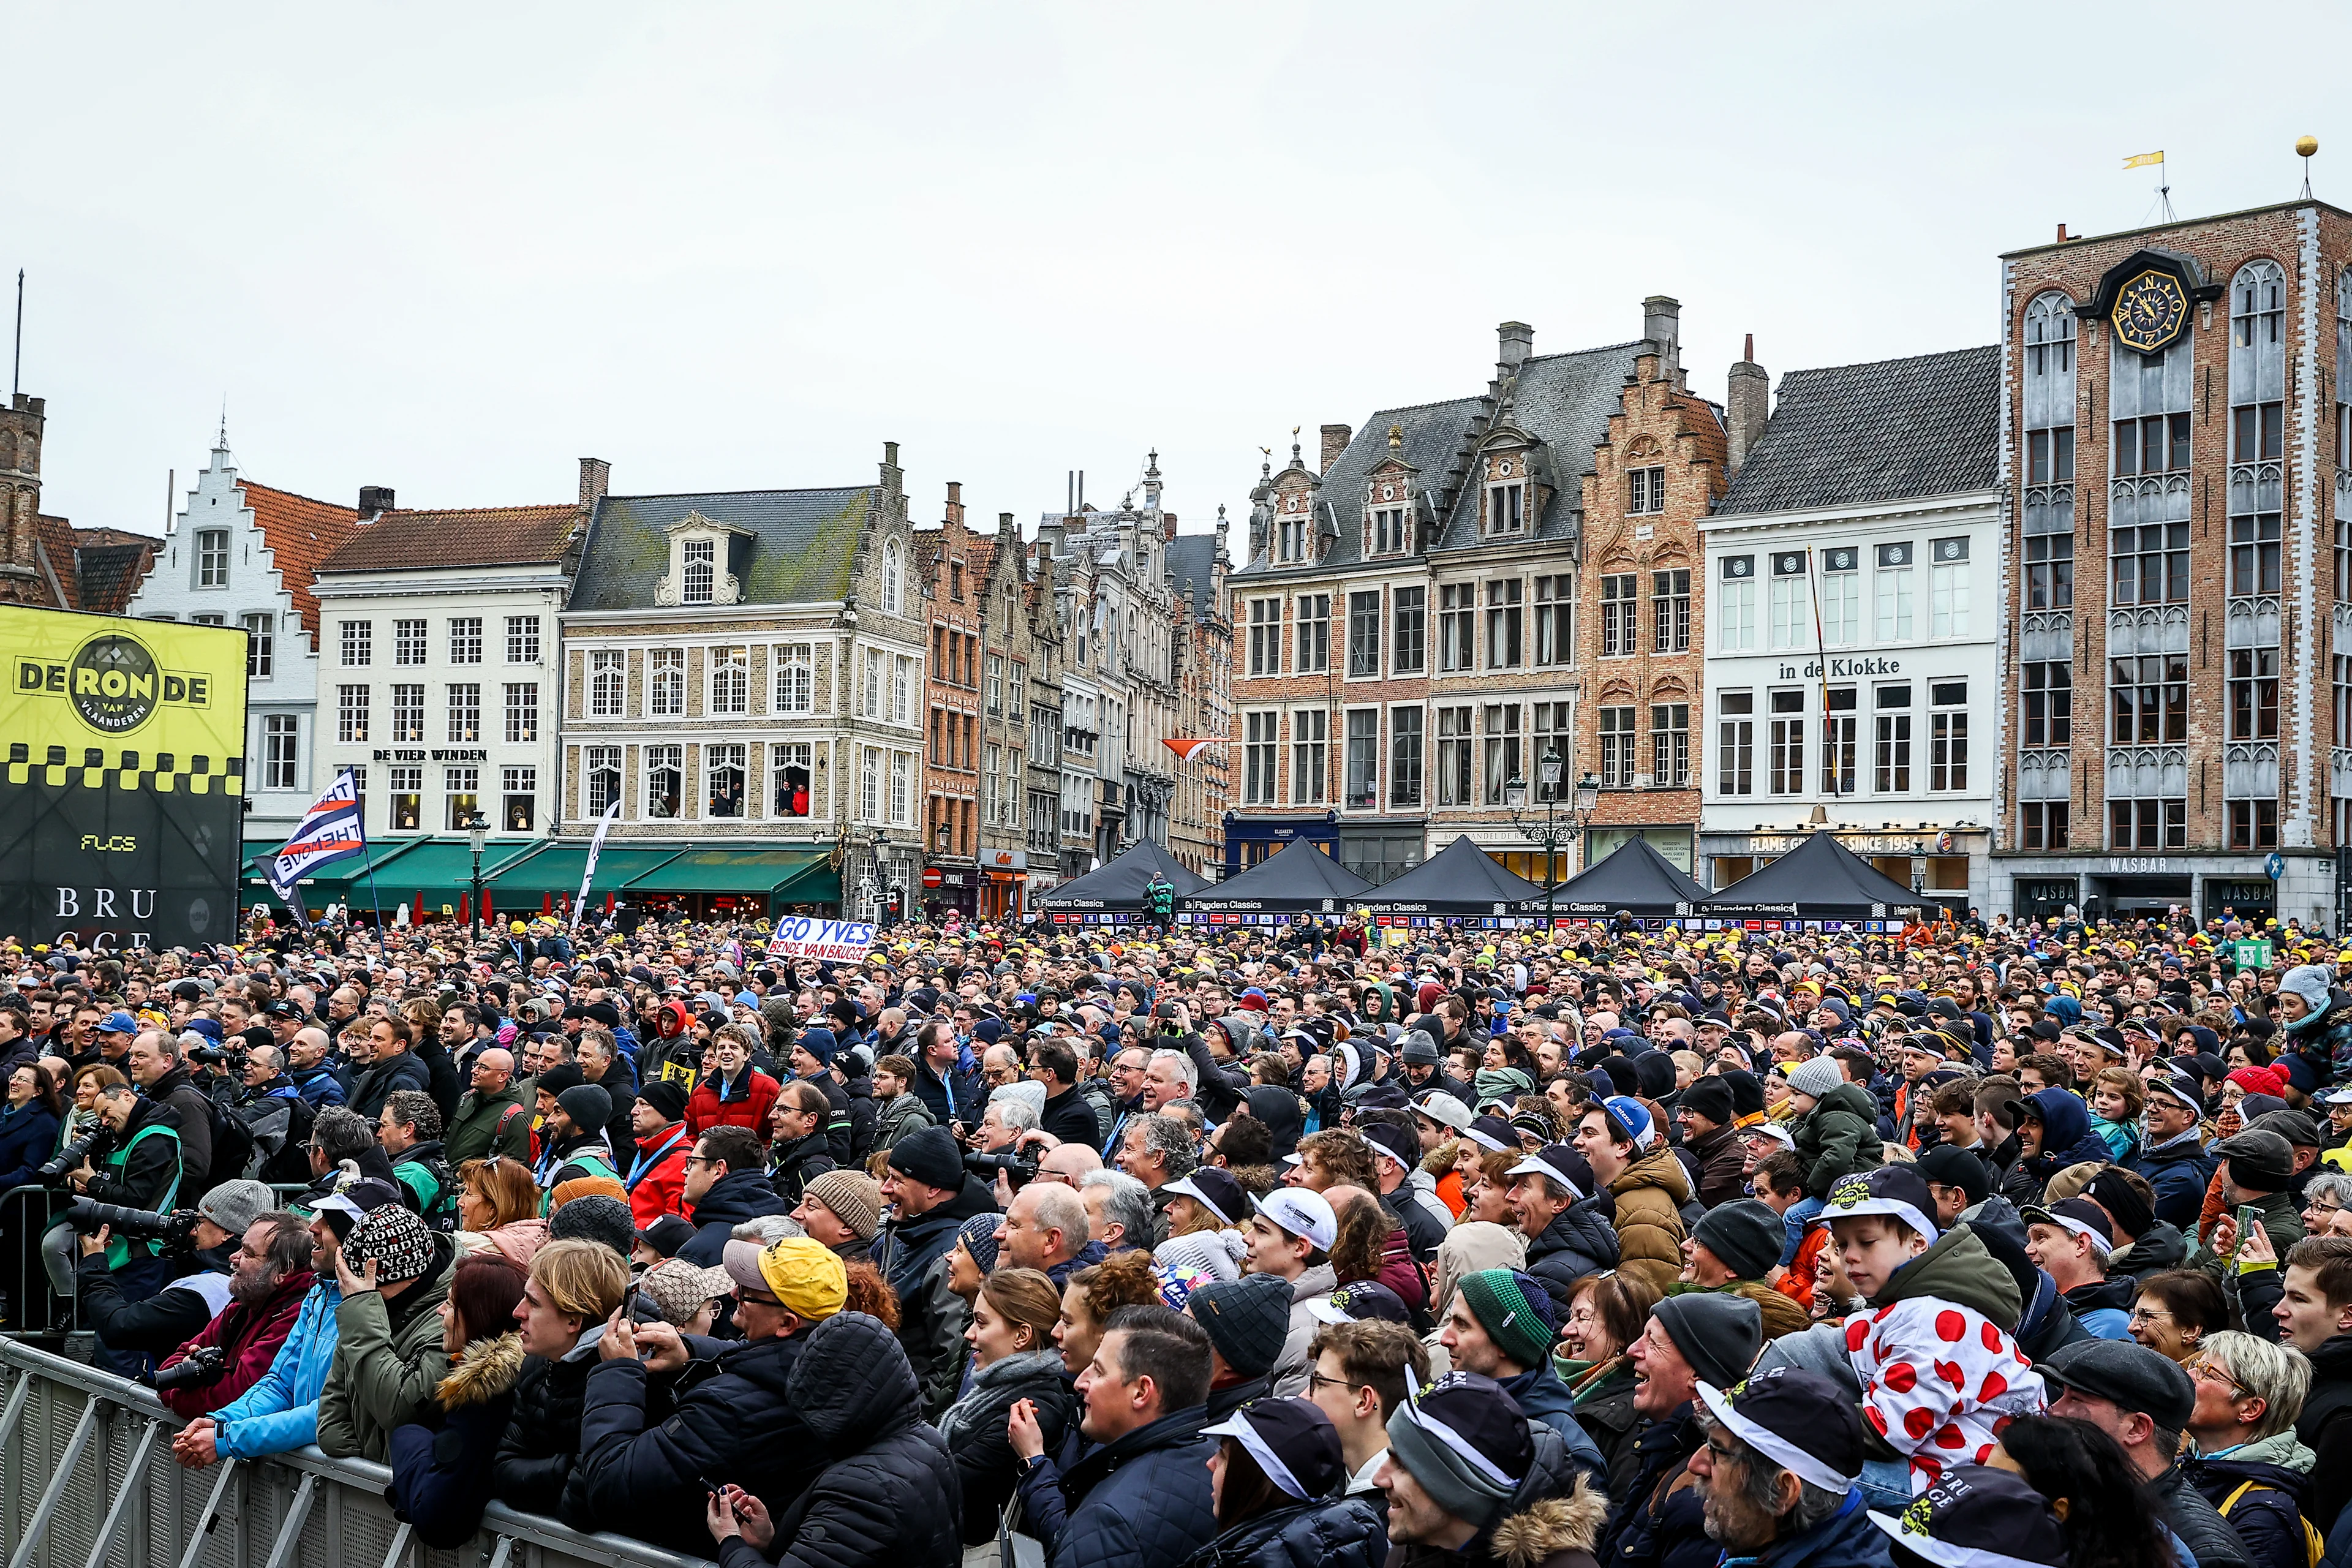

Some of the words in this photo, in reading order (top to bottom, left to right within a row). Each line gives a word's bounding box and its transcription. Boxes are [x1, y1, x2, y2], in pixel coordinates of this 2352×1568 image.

[1779, 663, 1796, 679] in
[1804, 661, 1823, 677] de
[1831, 657, 1900, 676] Klokke
[80, 699, 146, 728] VLAANDEREN
[102, 702, 124, 713] VAN
[373, 749, 391, 761] DE
[394, 749, 427, 761] VIER
[431, 748, 488, 761] WINDEN
[1749, 837, 1787, 852] FLAME
[1848, 836, 1882, 852] SINCE
[1887, 836, 1919, 851] 1954
[2109, 858, 2167, 873] WASBAR
[2222, 886, 2274, 900] WASBA
[1041, 899, 1072, 907] Flanders
[1073, 899, 1104, 908] Classics
[1195, 900, 1228, 909] Flanders
[1229, 900, 1262, 909] Classics
[1392, 902, 1427, 911] Classics
[1570, 902, 1607, 911] Classics
[777, 917, 811, 941] GO
[816, 920, 878, 946] YVES!
[769, 940, 802, 954] BENDE
[804, 943, 828, 957] VAN
[826, 944, 867, 961] BRUGGE
[1615, 1104, 1634, 1126] latexco
[1834, 1182, 1869, 1196] MAAKT
[1940, 1471, 1973, 1496] BRU
[1928, 1488, 1954, 1508] GE
